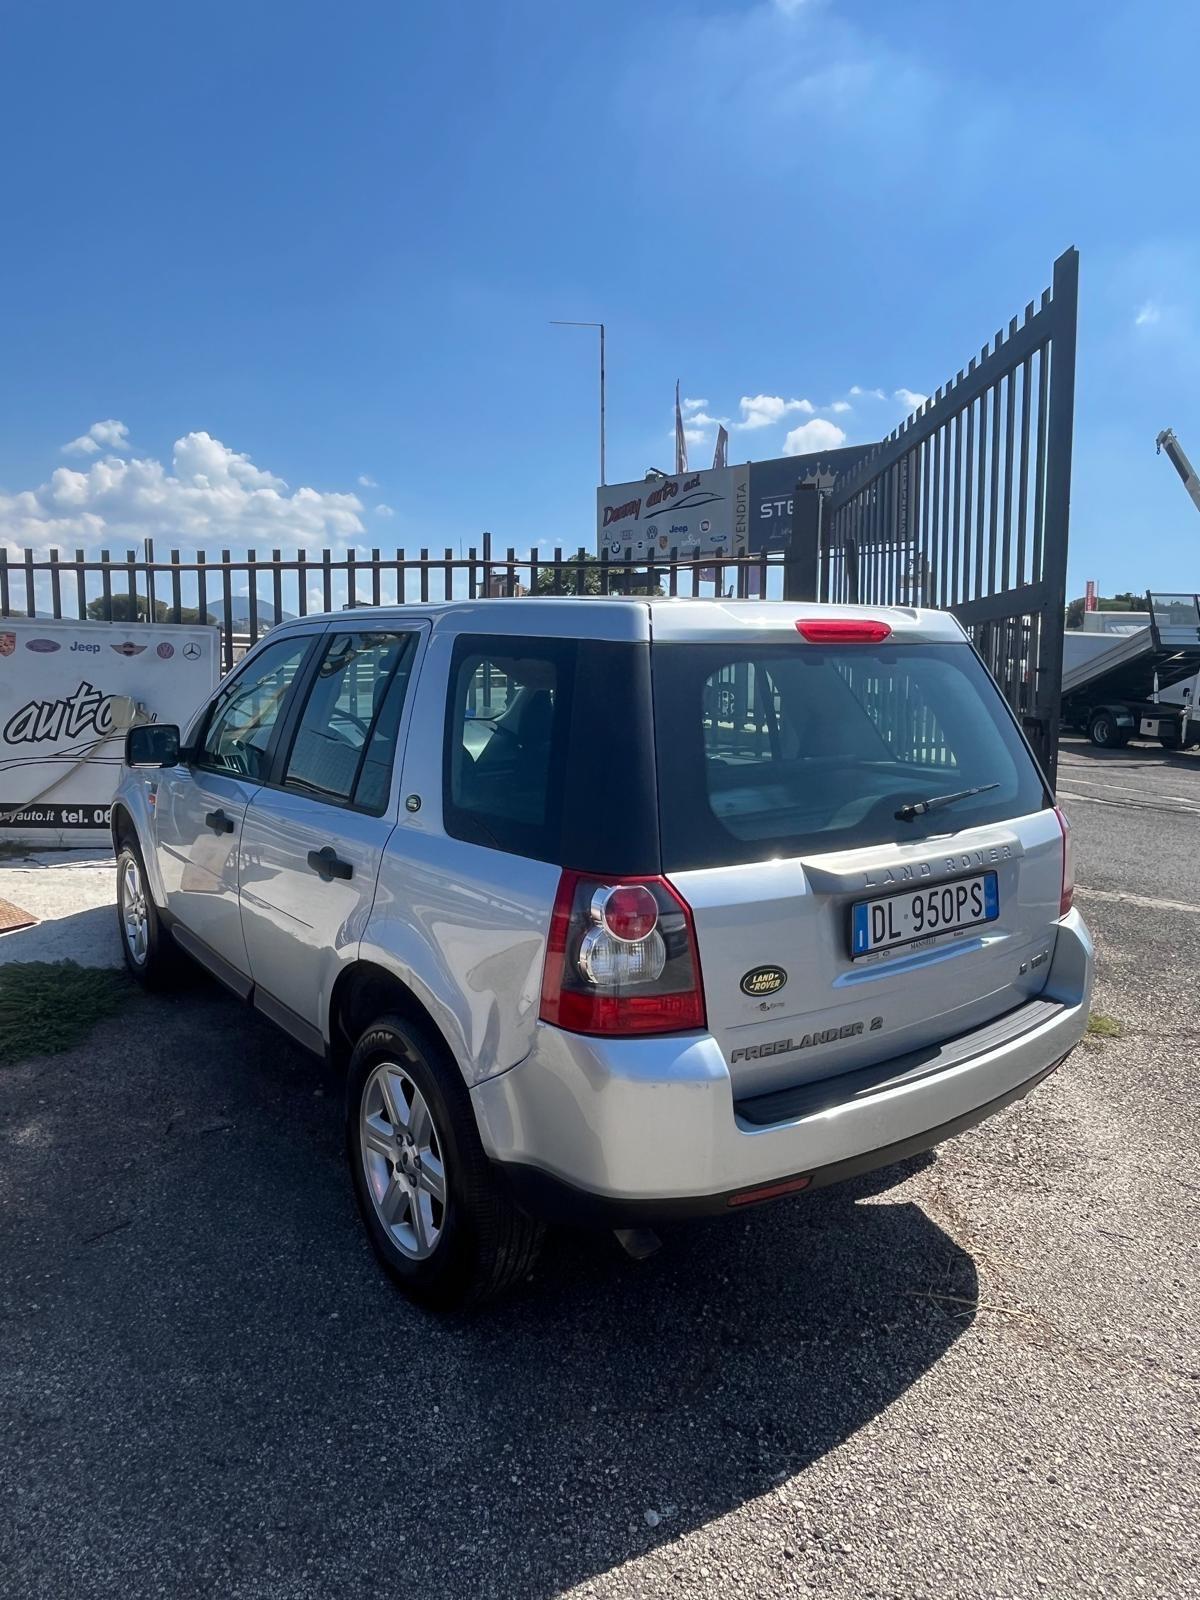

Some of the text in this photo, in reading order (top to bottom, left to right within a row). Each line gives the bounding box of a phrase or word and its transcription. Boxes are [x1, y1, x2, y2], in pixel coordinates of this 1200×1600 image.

[645, 481, 679, 508] auto
[669, 525, 688, 533] Jeep
[735, 482, 747, 544] VENDITA
[70, 641, 101, 654] Jeep
[61, 809, 89, 823] tel.
[863, 845, 1012, 887] LAND ROVER
[872, 882, 983, 944] DL 950PS
[730, 1016, 884, 1063] FREELANDER 2
